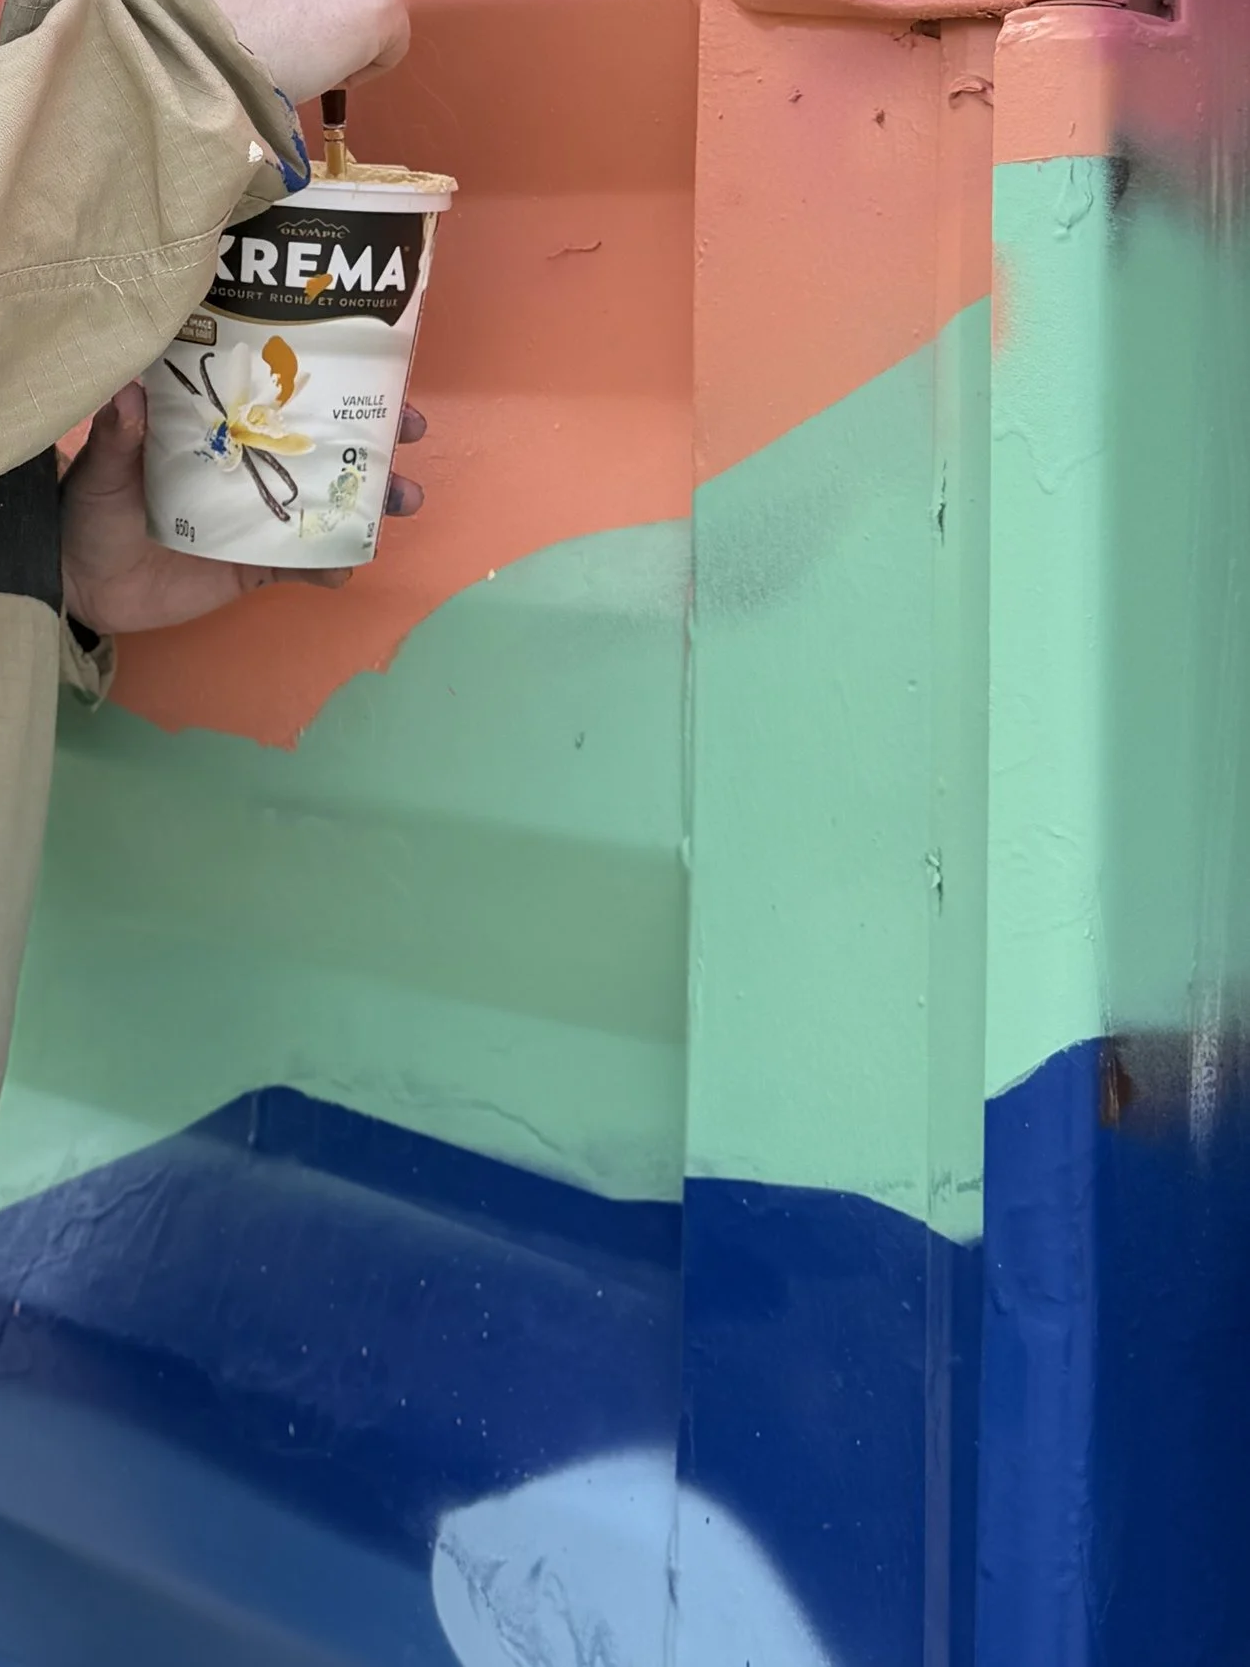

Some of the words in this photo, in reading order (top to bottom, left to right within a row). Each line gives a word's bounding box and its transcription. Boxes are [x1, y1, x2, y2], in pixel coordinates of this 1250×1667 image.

[280, 227, 347, 239] OLYMPIC
[215, 234, 406, 291] KREMA
[210, 285, 262, 301] OGOURT
[318, 296, 333, 306] ET
[339, 297, 399, 308] ONCTUEUX
[342, 395, 385, 406] VANILLE
